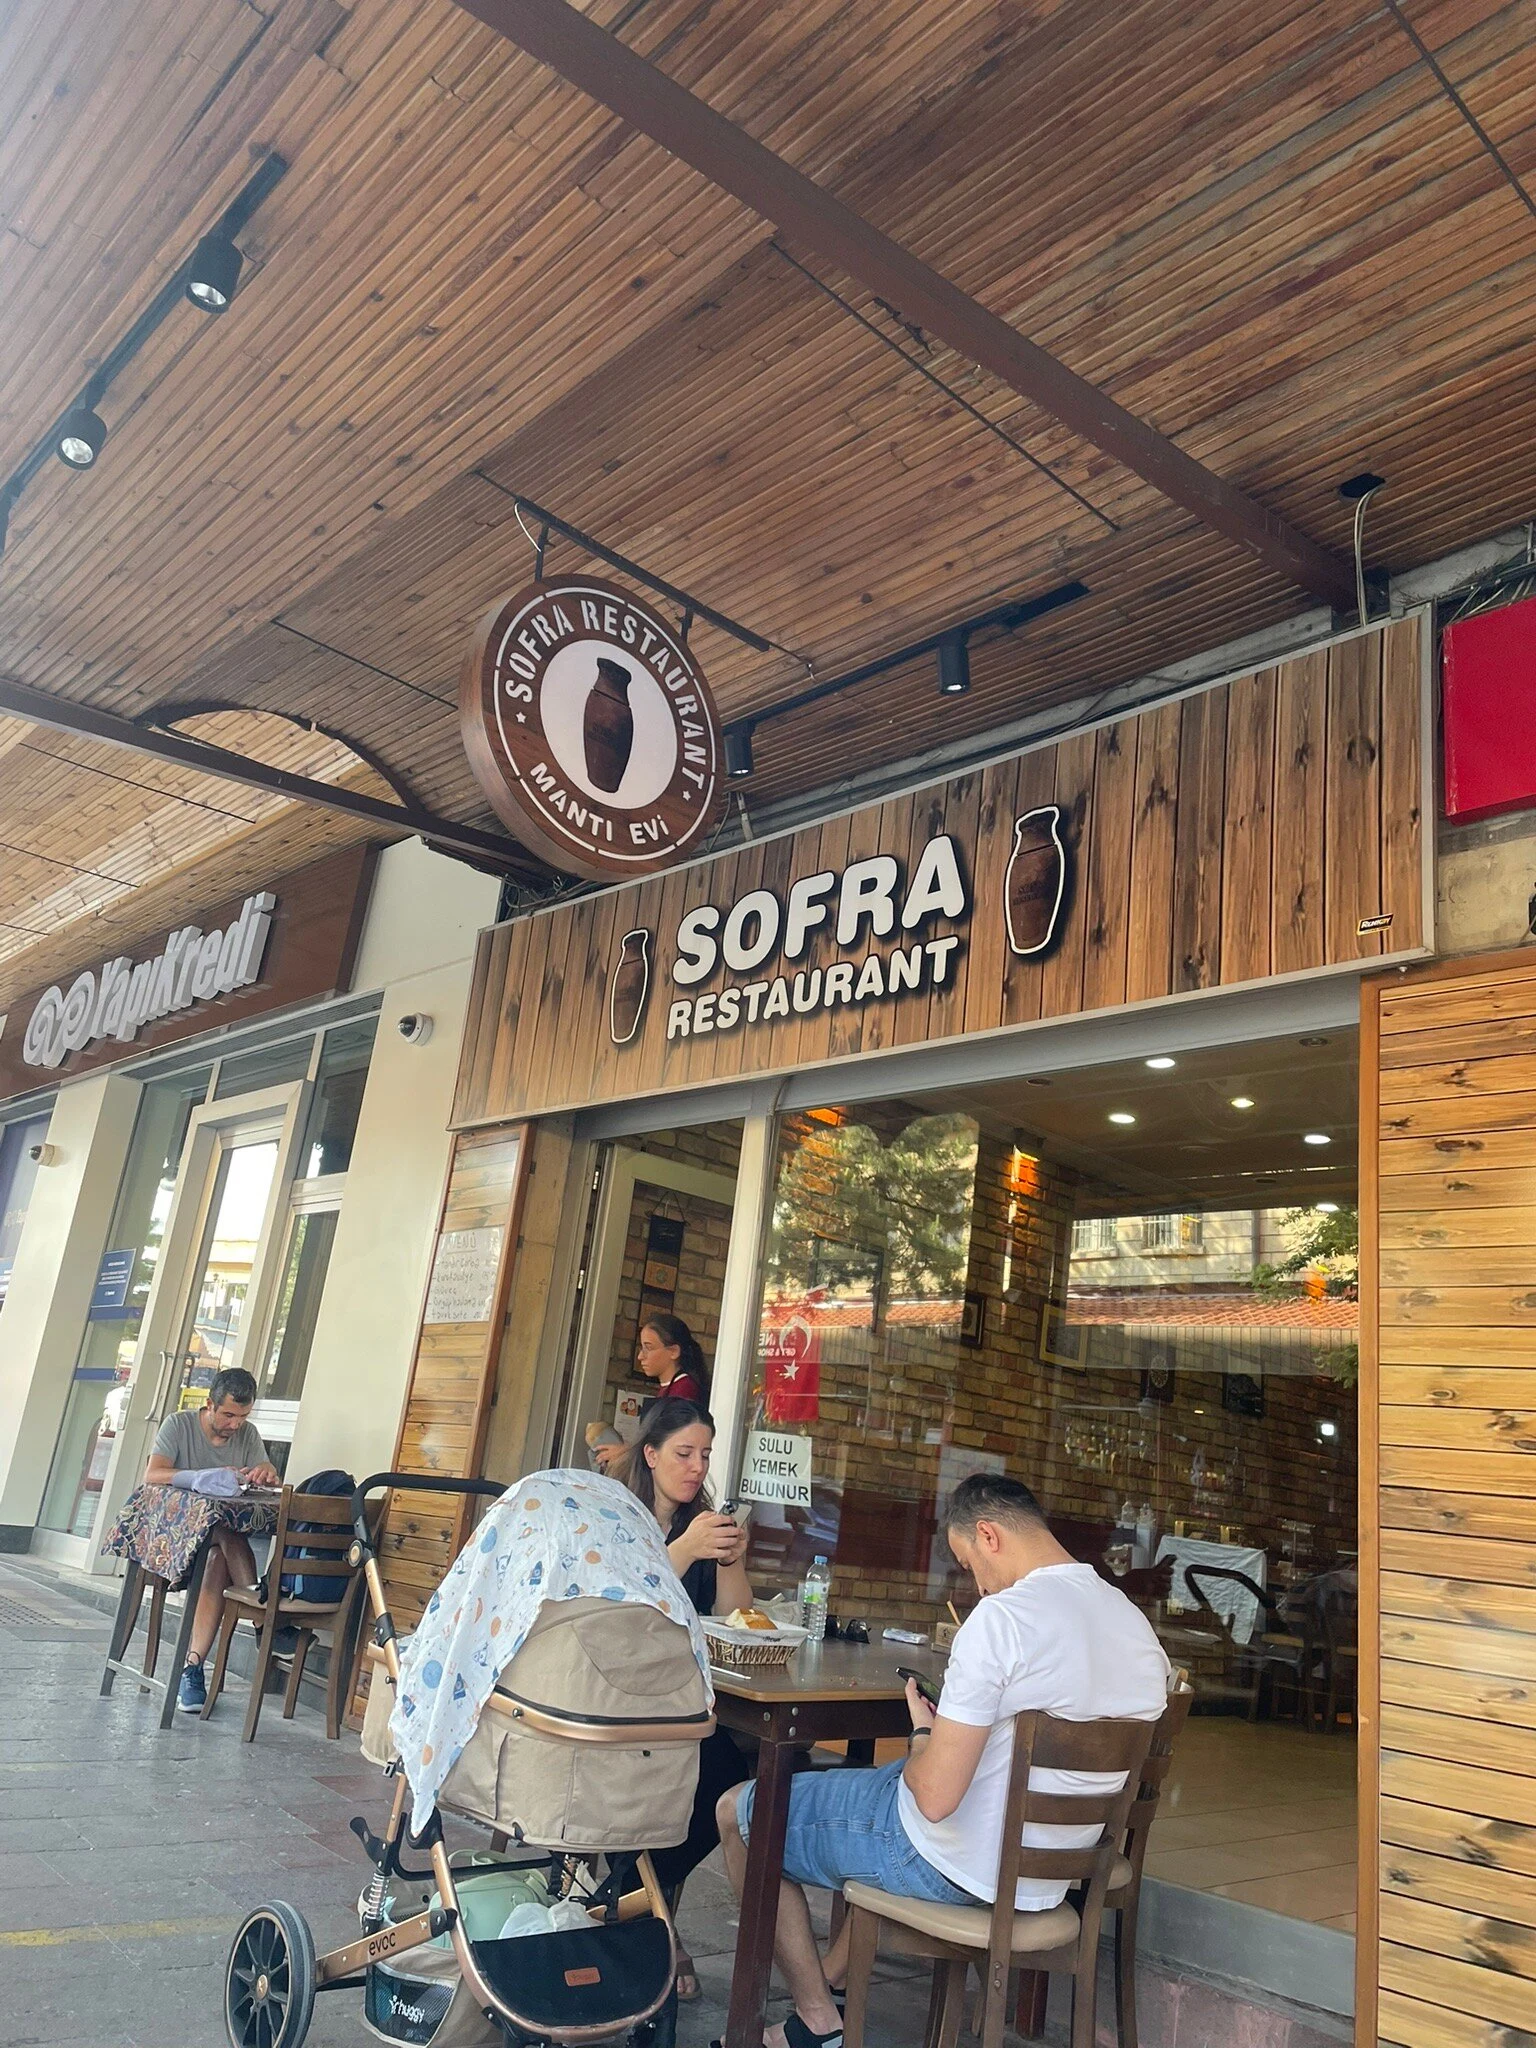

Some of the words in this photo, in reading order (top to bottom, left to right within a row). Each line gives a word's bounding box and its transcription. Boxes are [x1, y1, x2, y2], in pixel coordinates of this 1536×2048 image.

[505, 604, 574, 703] SOFRA
[581, 600, 707, 789] RESTAURANT
[530, 762, 612, 842] MANTI
[672, 834, 965, 984] SOFRA
[667, 936, 958, 1040] RESTAURANT
[752, 1457, 799, 1478] YEMEK
[758, 1437, 793, 1455] SULU
[740, 1478, 810, 1502] BULUNUR
